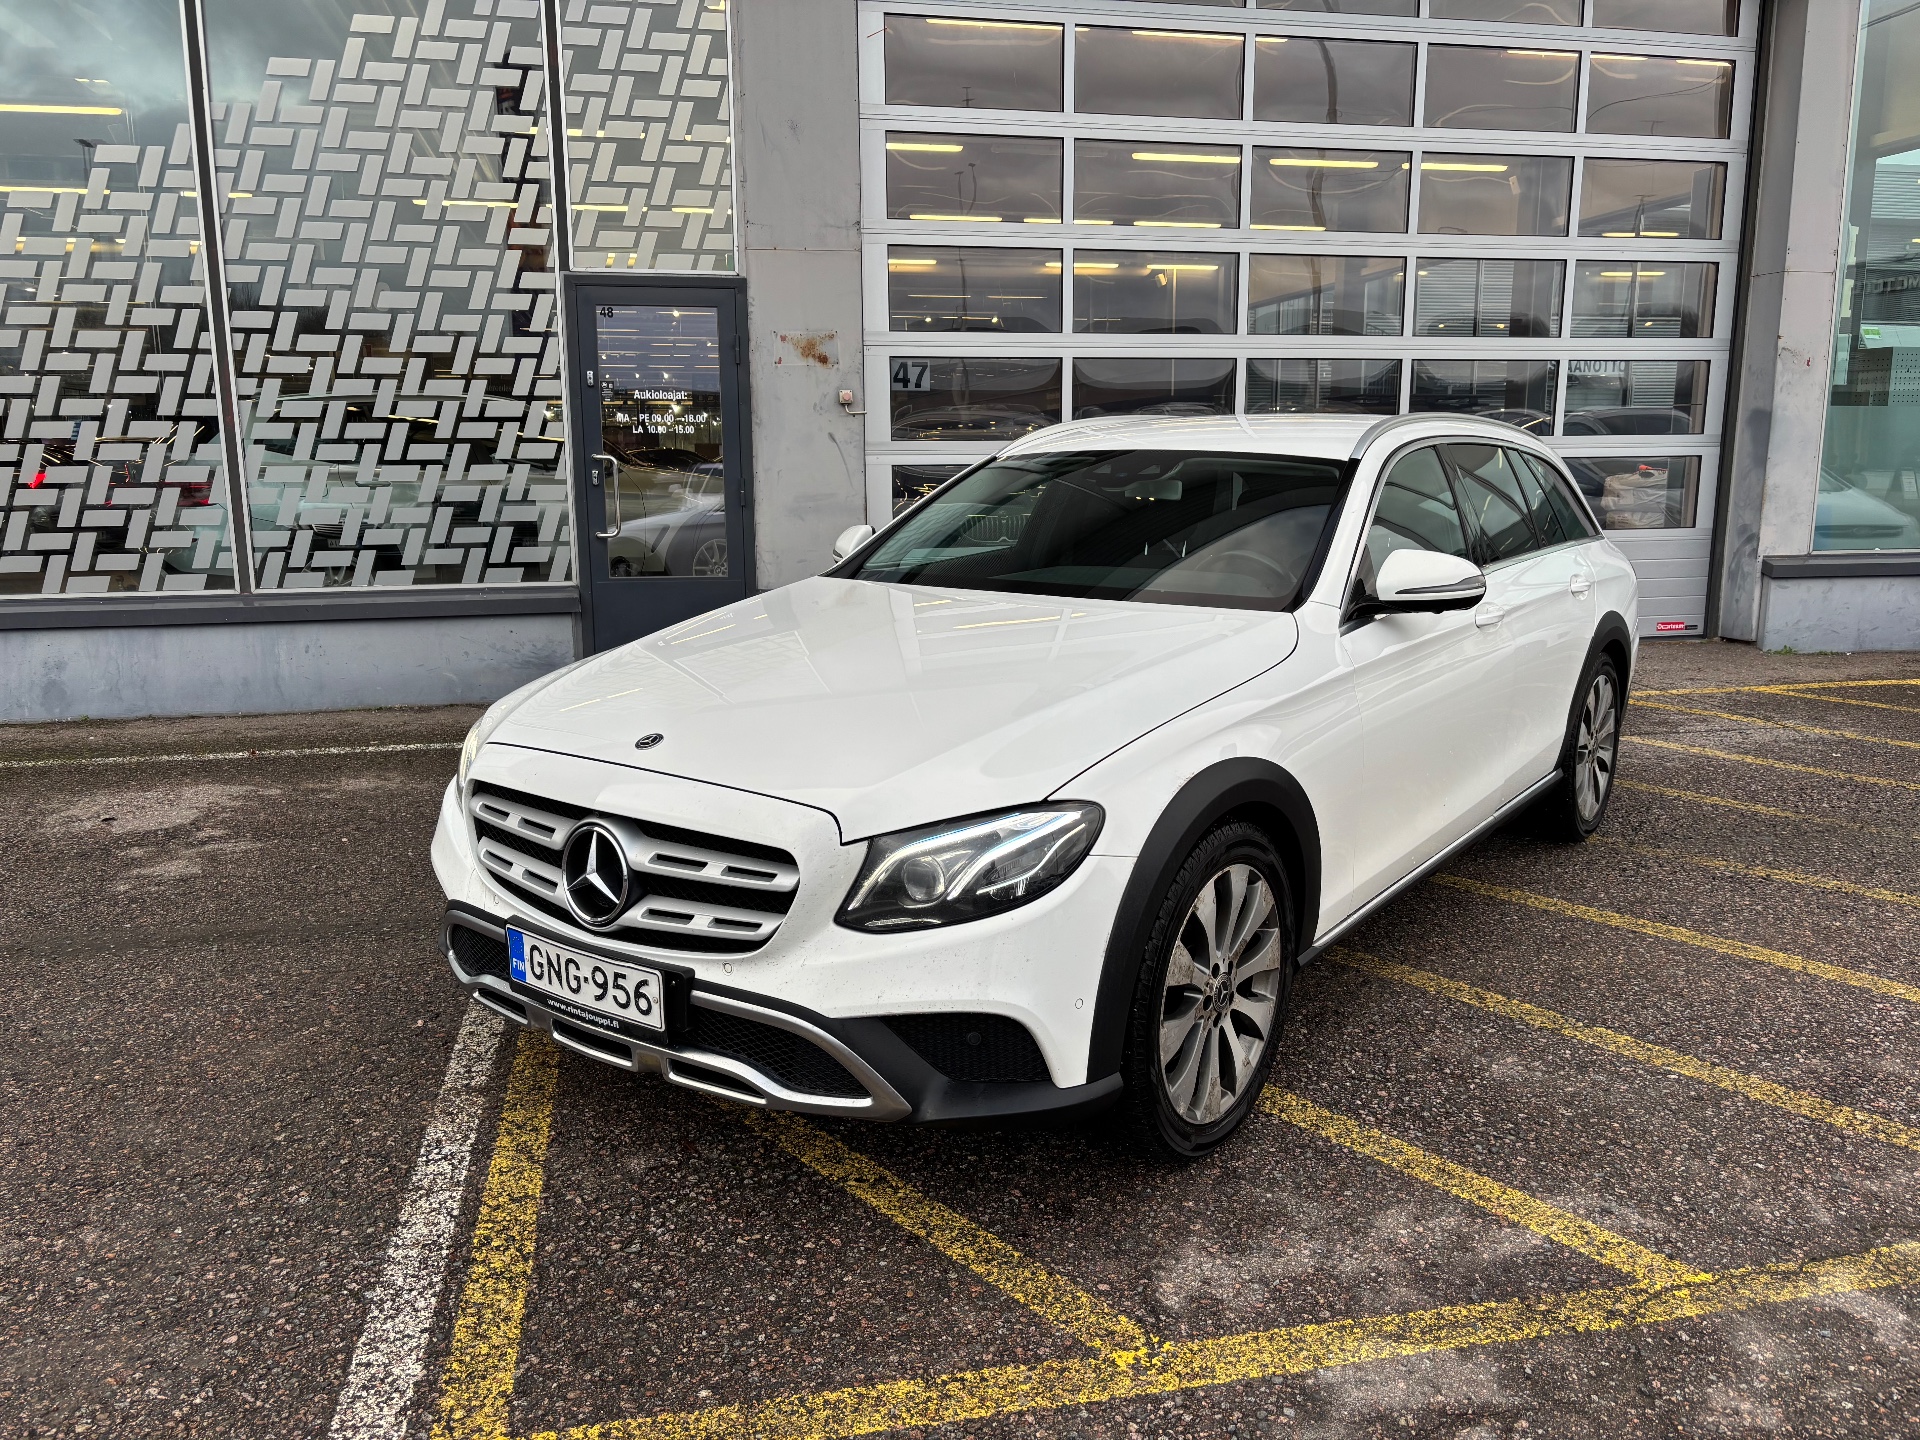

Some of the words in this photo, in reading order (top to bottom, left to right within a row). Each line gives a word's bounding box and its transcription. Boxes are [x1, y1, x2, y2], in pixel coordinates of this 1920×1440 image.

[600, 307, 614, 318] 48
[893, 361, 929, 389] 47
[633, 390, 688, 401] Aukioloajat:
[616, 414, 630, 423] MA
[639, 413, 650, 423] PE
[651, 414, 674, 423] 09.00
[684, 414, 706, 423] 18.00
[632, 425, 644, 434] LA
[675, 425, 695, 434] 15.00
[512, 957, 525, 973] FIN
[529, 943, 653, 1016] GNG-956
